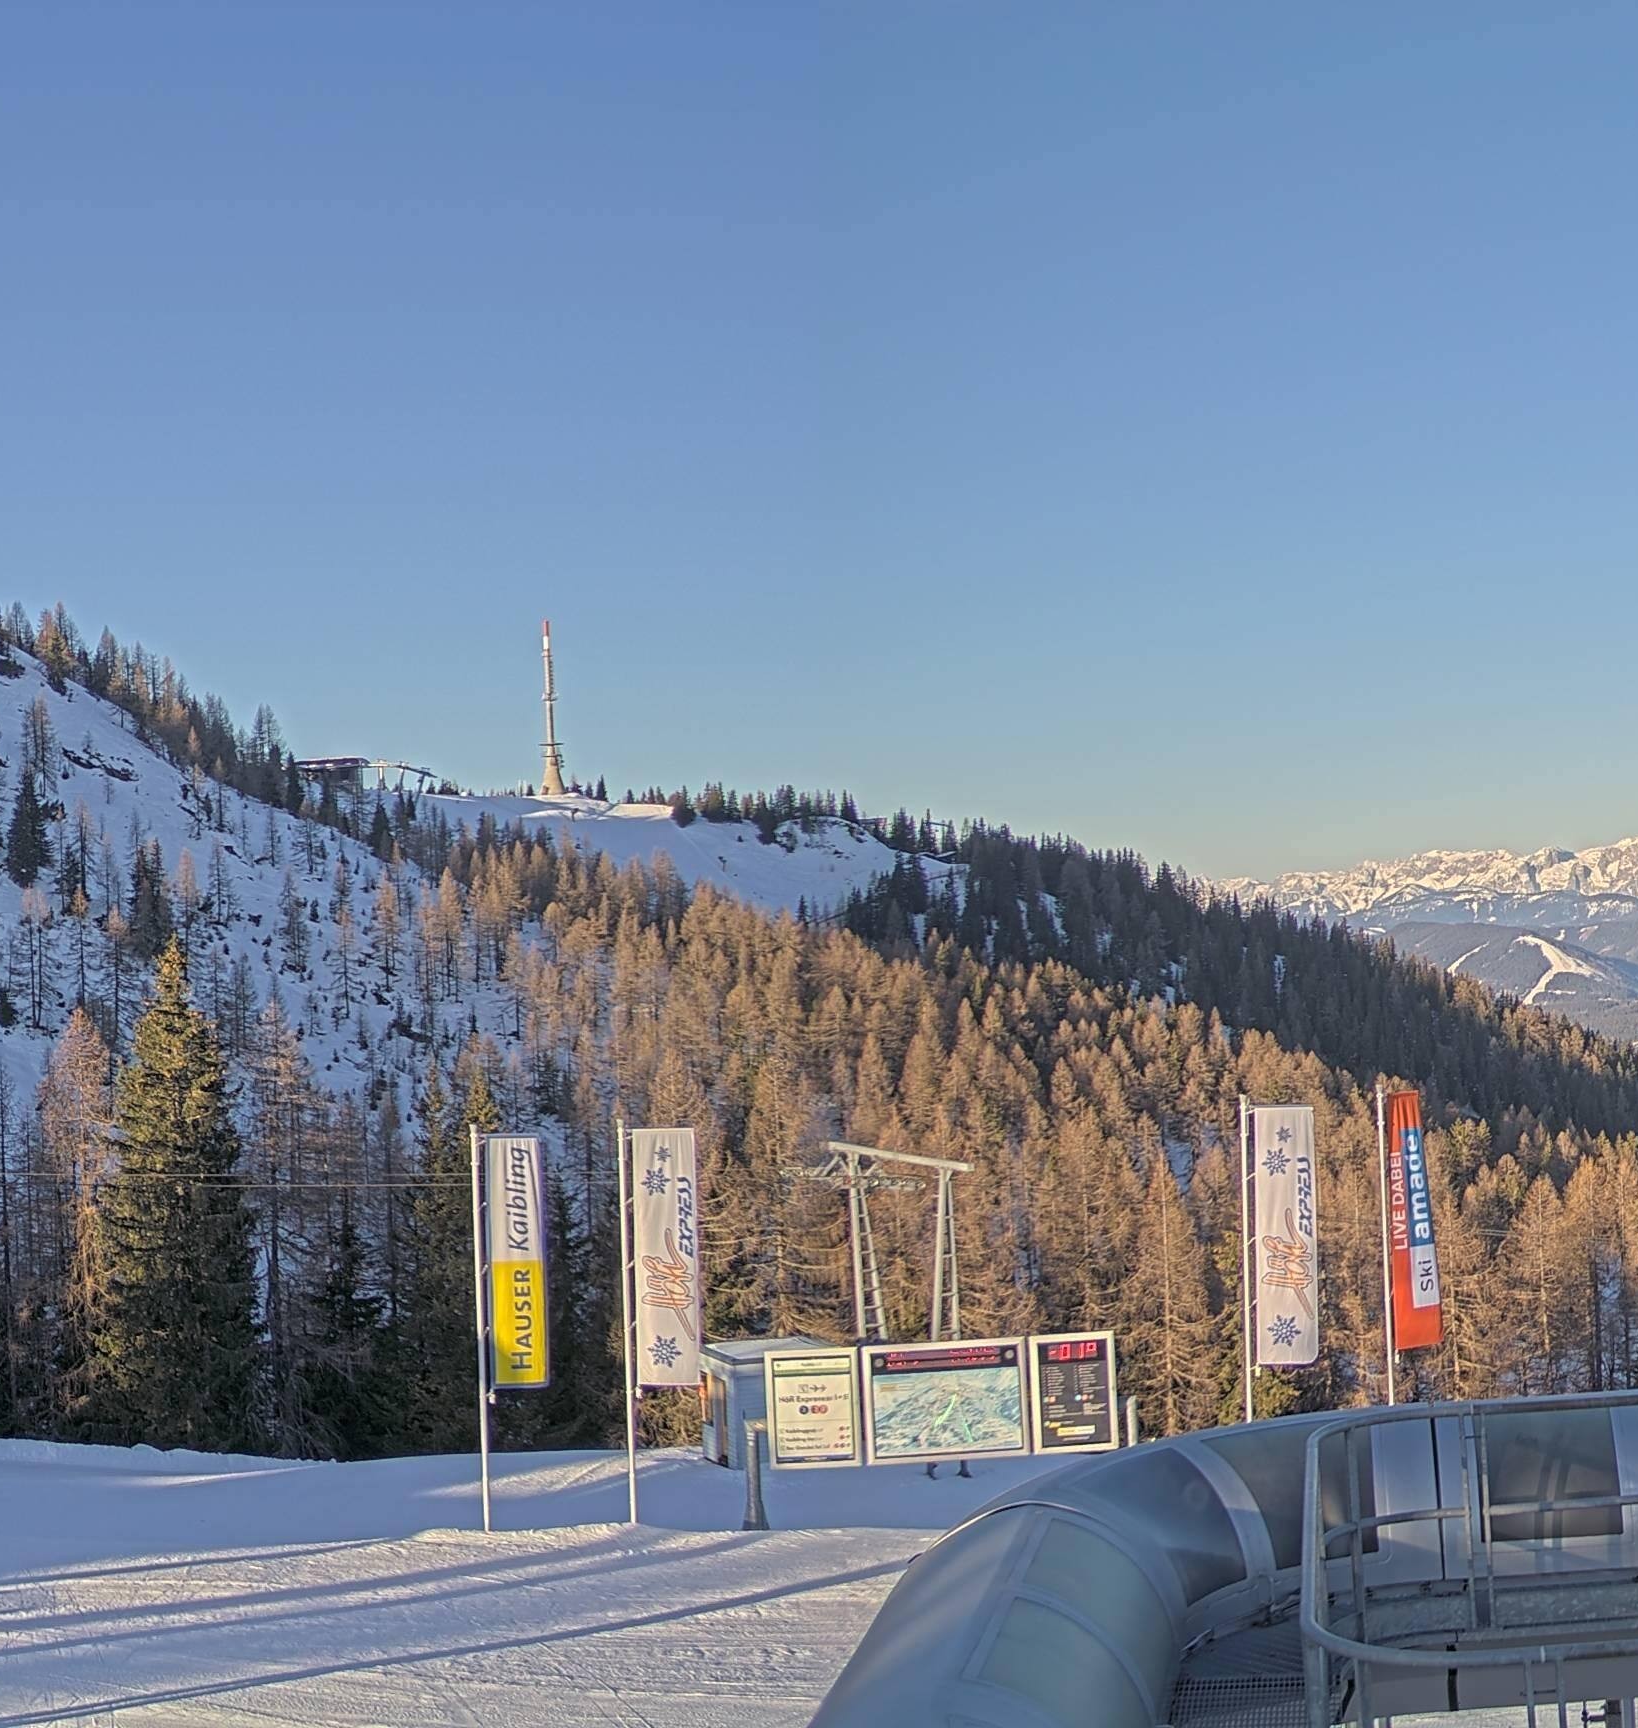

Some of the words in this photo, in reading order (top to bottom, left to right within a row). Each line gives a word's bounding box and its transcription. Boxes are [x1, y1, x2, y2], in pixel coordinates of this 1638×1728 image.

[505, 1146, 535, 1252] Kaibling
[676, 1176, 695, 1258] EXPRESS
[1296, 1157, 1314, 1238] EXPRESS
[1389, 1152, 1408, 1207] DABEI
[1391, 1209, 1409, 1250] LIVE
[1418, 1258, 1434, 1292] Ski
[511, 1268, 533, 1371] HAUSER
